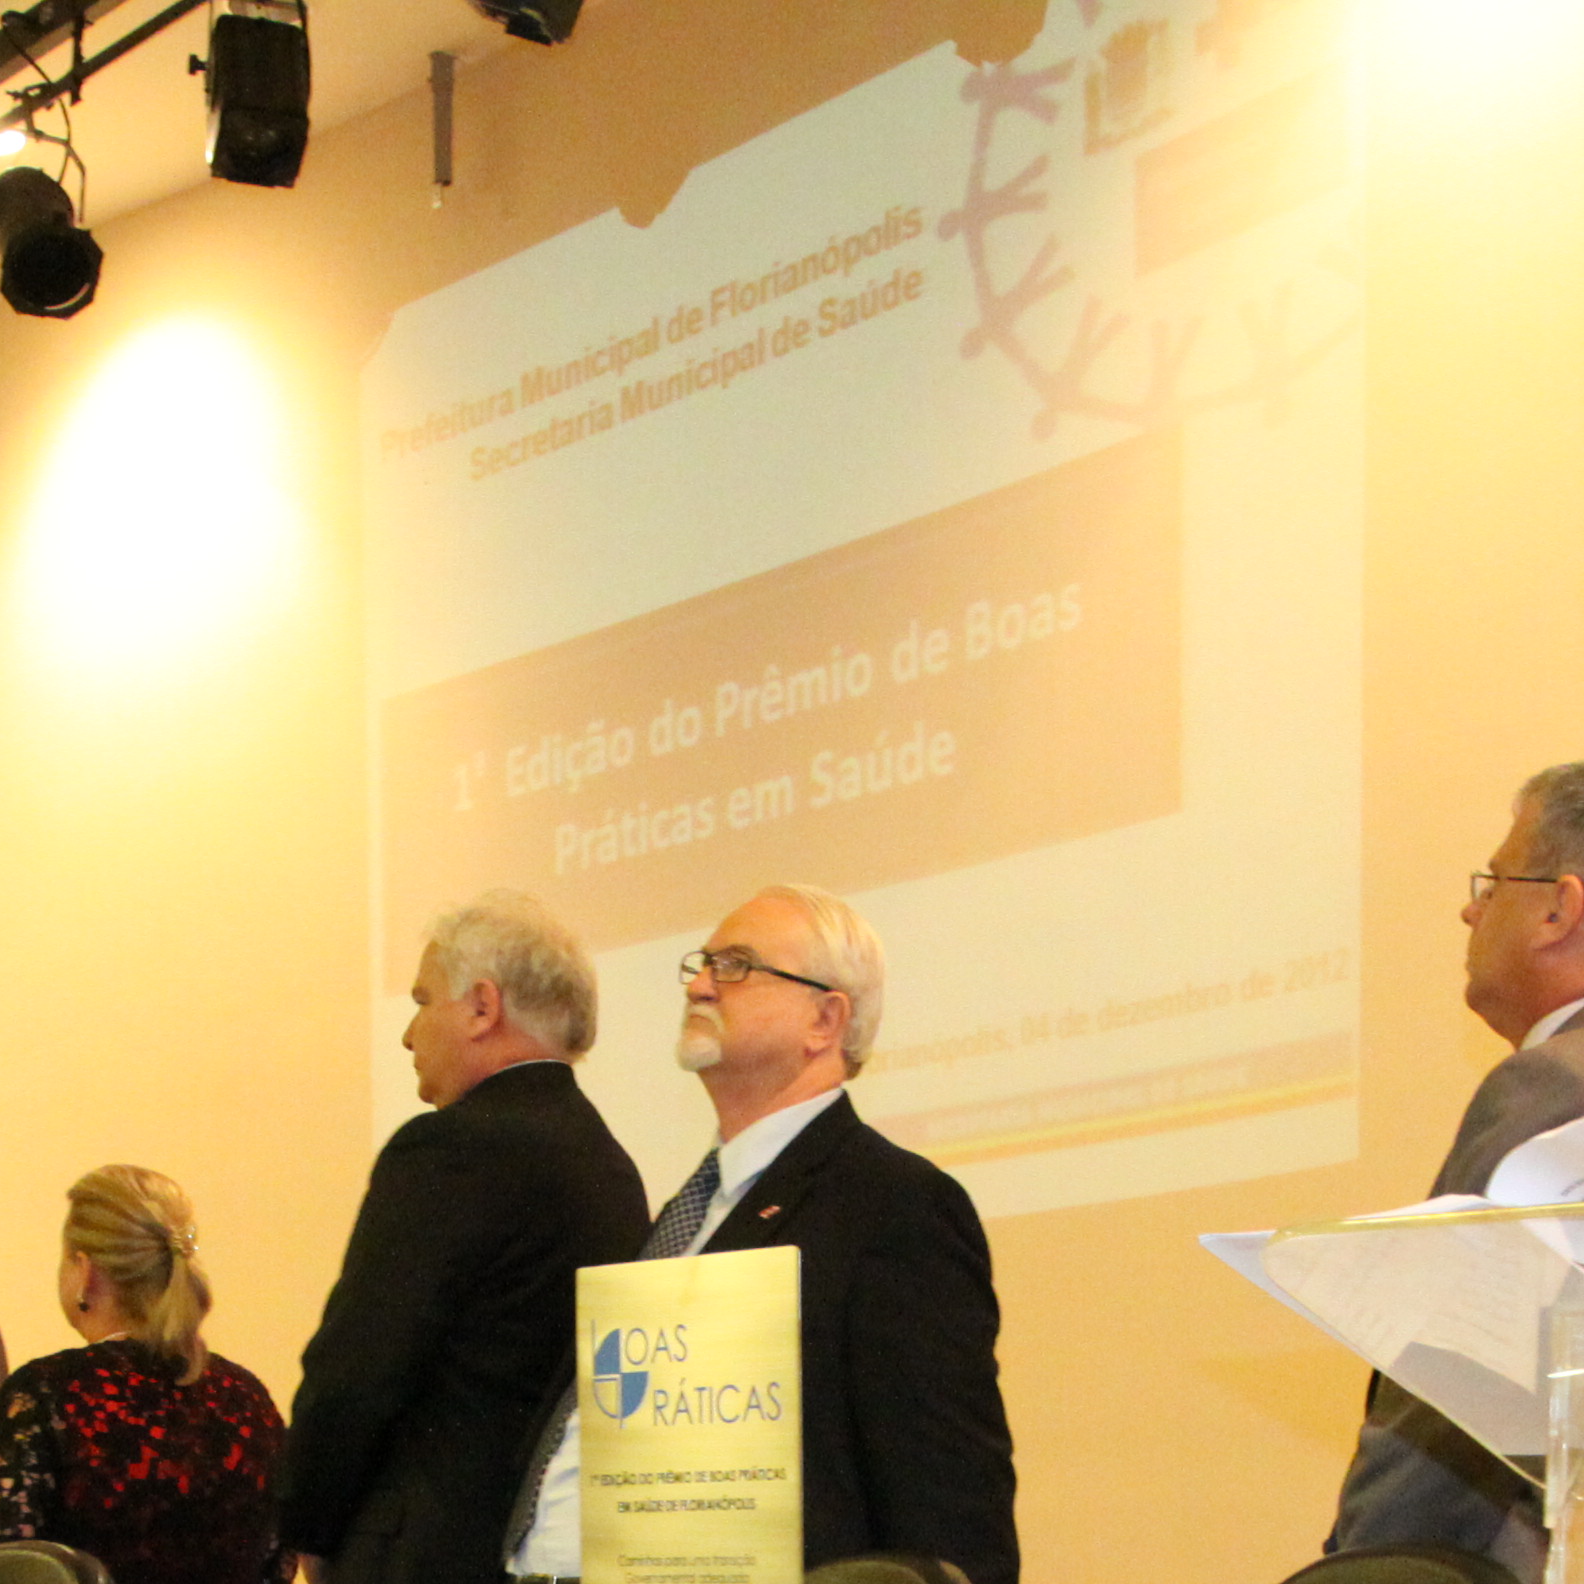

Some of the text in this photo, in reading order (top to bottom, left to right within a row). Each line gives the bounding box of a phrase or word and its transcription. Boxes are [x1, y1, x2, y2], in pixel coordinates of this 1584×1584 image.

[379, 205, 925, 464] Prefeitura Municipal de Florianópolis
[469, 266, 925, 482] Secretaria Municipal de Saúde
[505, 718, 634, 798] Edição
[648, 699, 703, 757] do
[714, 641, 875, 738] Prêmio
[890, 619, 951, 684] de
[964, 581, 1083, 661] Boas
[553, 720, 957, 875] Práticas em Saúde
[1056, 1006, 1090, 1040] de
[1096, 981, 1232, 1033] dezembro
[1239, 969, 1275, 1001] de
[1282, 947, 1350, 995] 2012
